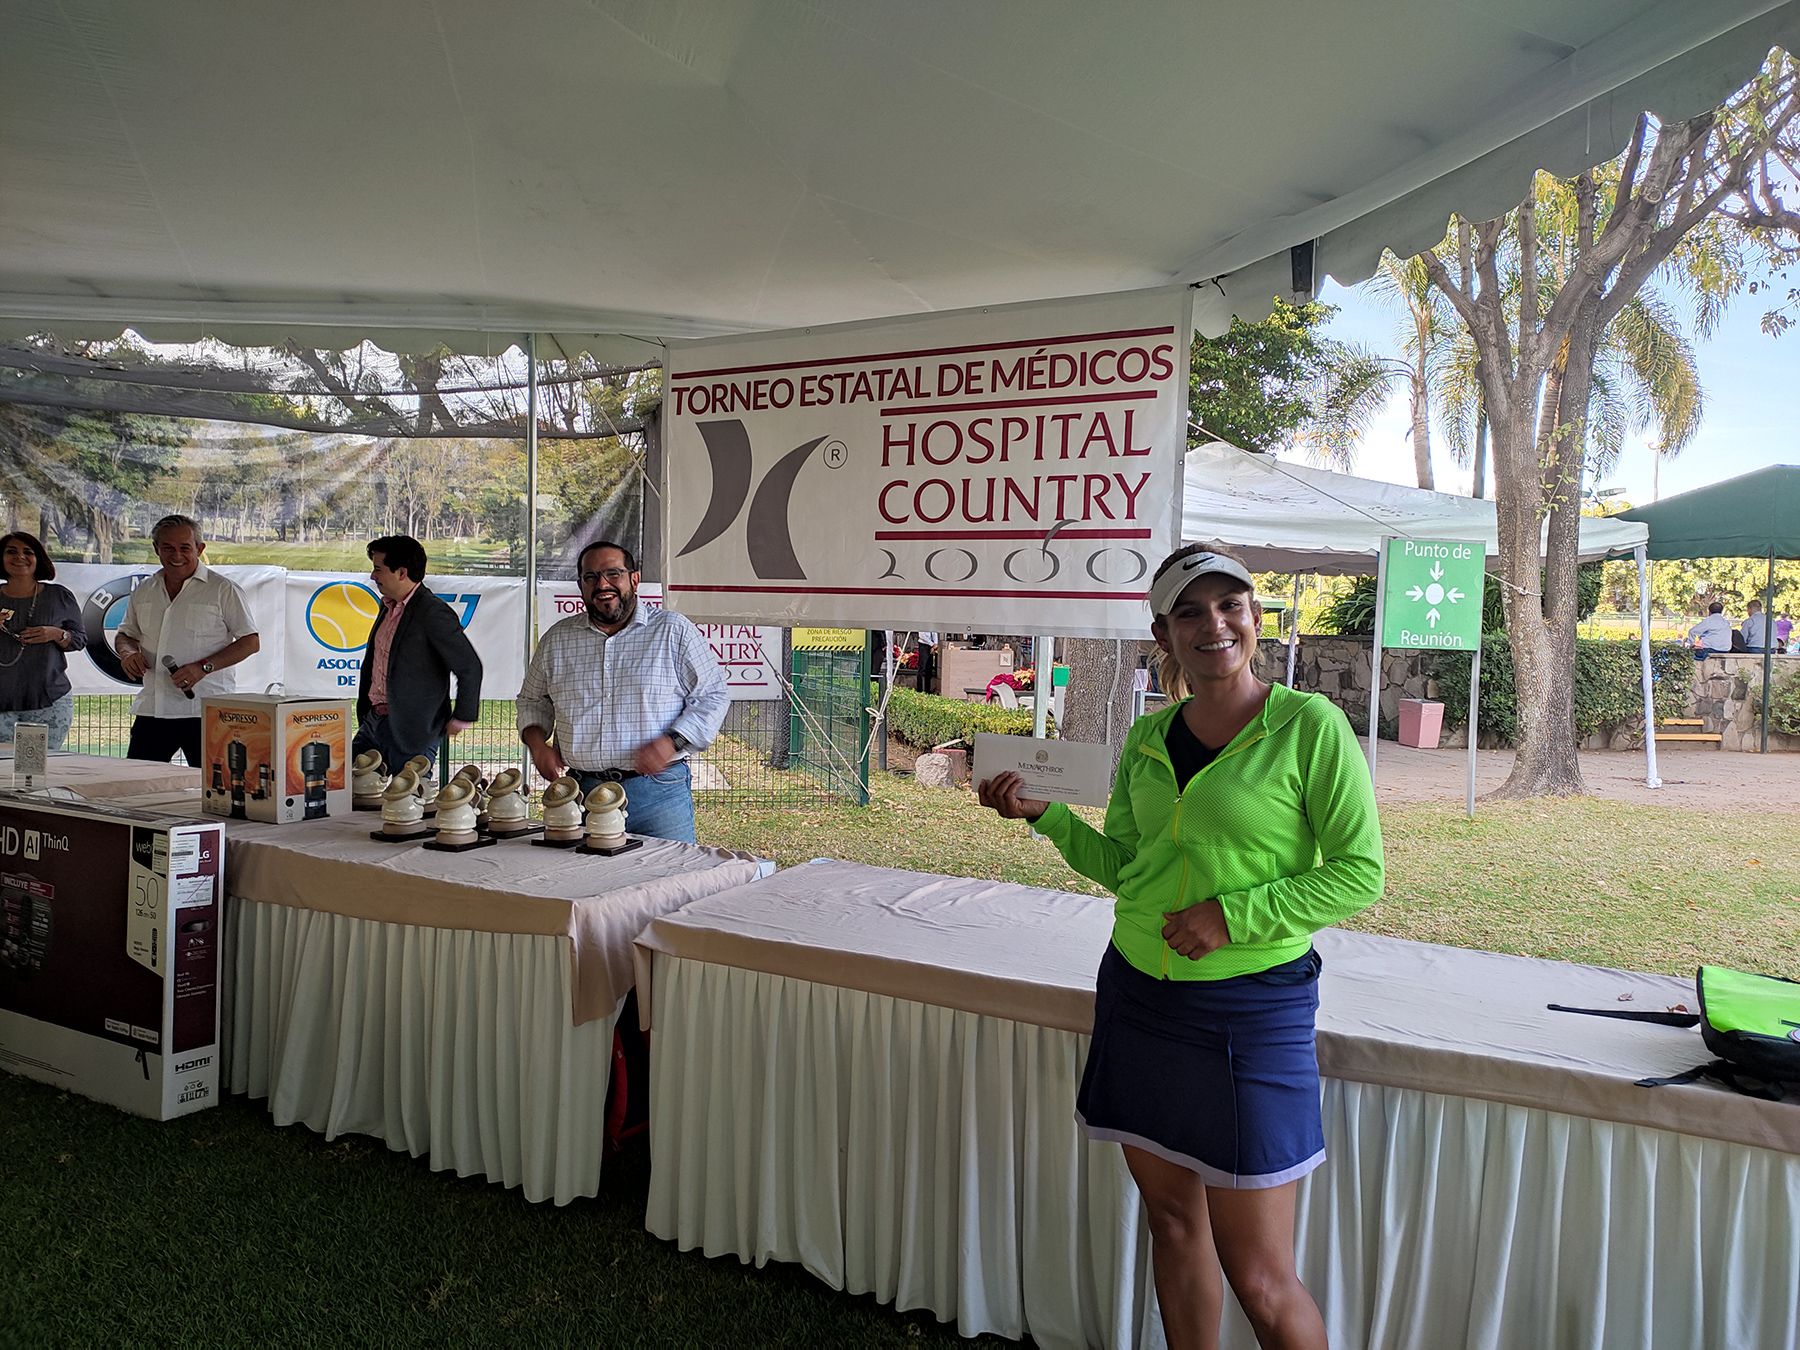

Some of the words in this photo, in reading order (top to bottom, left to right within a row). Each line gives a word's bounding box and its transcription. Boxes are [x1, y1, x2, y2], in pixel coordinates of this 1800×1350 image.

[671, 377, 795, 416] TORNEO
[799, 366, 932, 407] ESTATAL
[937, 360, 985, 397] DE
[990, 344, 1174, 393] MÉDICOS
[880, 409, 1152, 467] HOSPITAL
[878, 471, 1152, 524] COUNTRY
[1404, 540, 1449, 559] Punto
[1452, 543, 1472, 560] de
[554, 600, 585, 614] TOR
[811, 635, 847, 643] PRECAUCIÓN
[1401, 630, 1462, 648] Reunión
[709, 643, 763, 660] NTRY
[317, 658, 361, 670] ASOCI
[337, 675, 356, 687] DE
[218, 710, 258, 725] NESPRESSO
[293, 713, 339, 724] NESPRESSO
[25, 835, 38, 855] AI
[42, 832, 70, 852] ThinQ
[3, 876, 29, 890] INCLUYE
[135, 875, 158, 909] 50
[175, 1056, 211, 1072] HDMI
